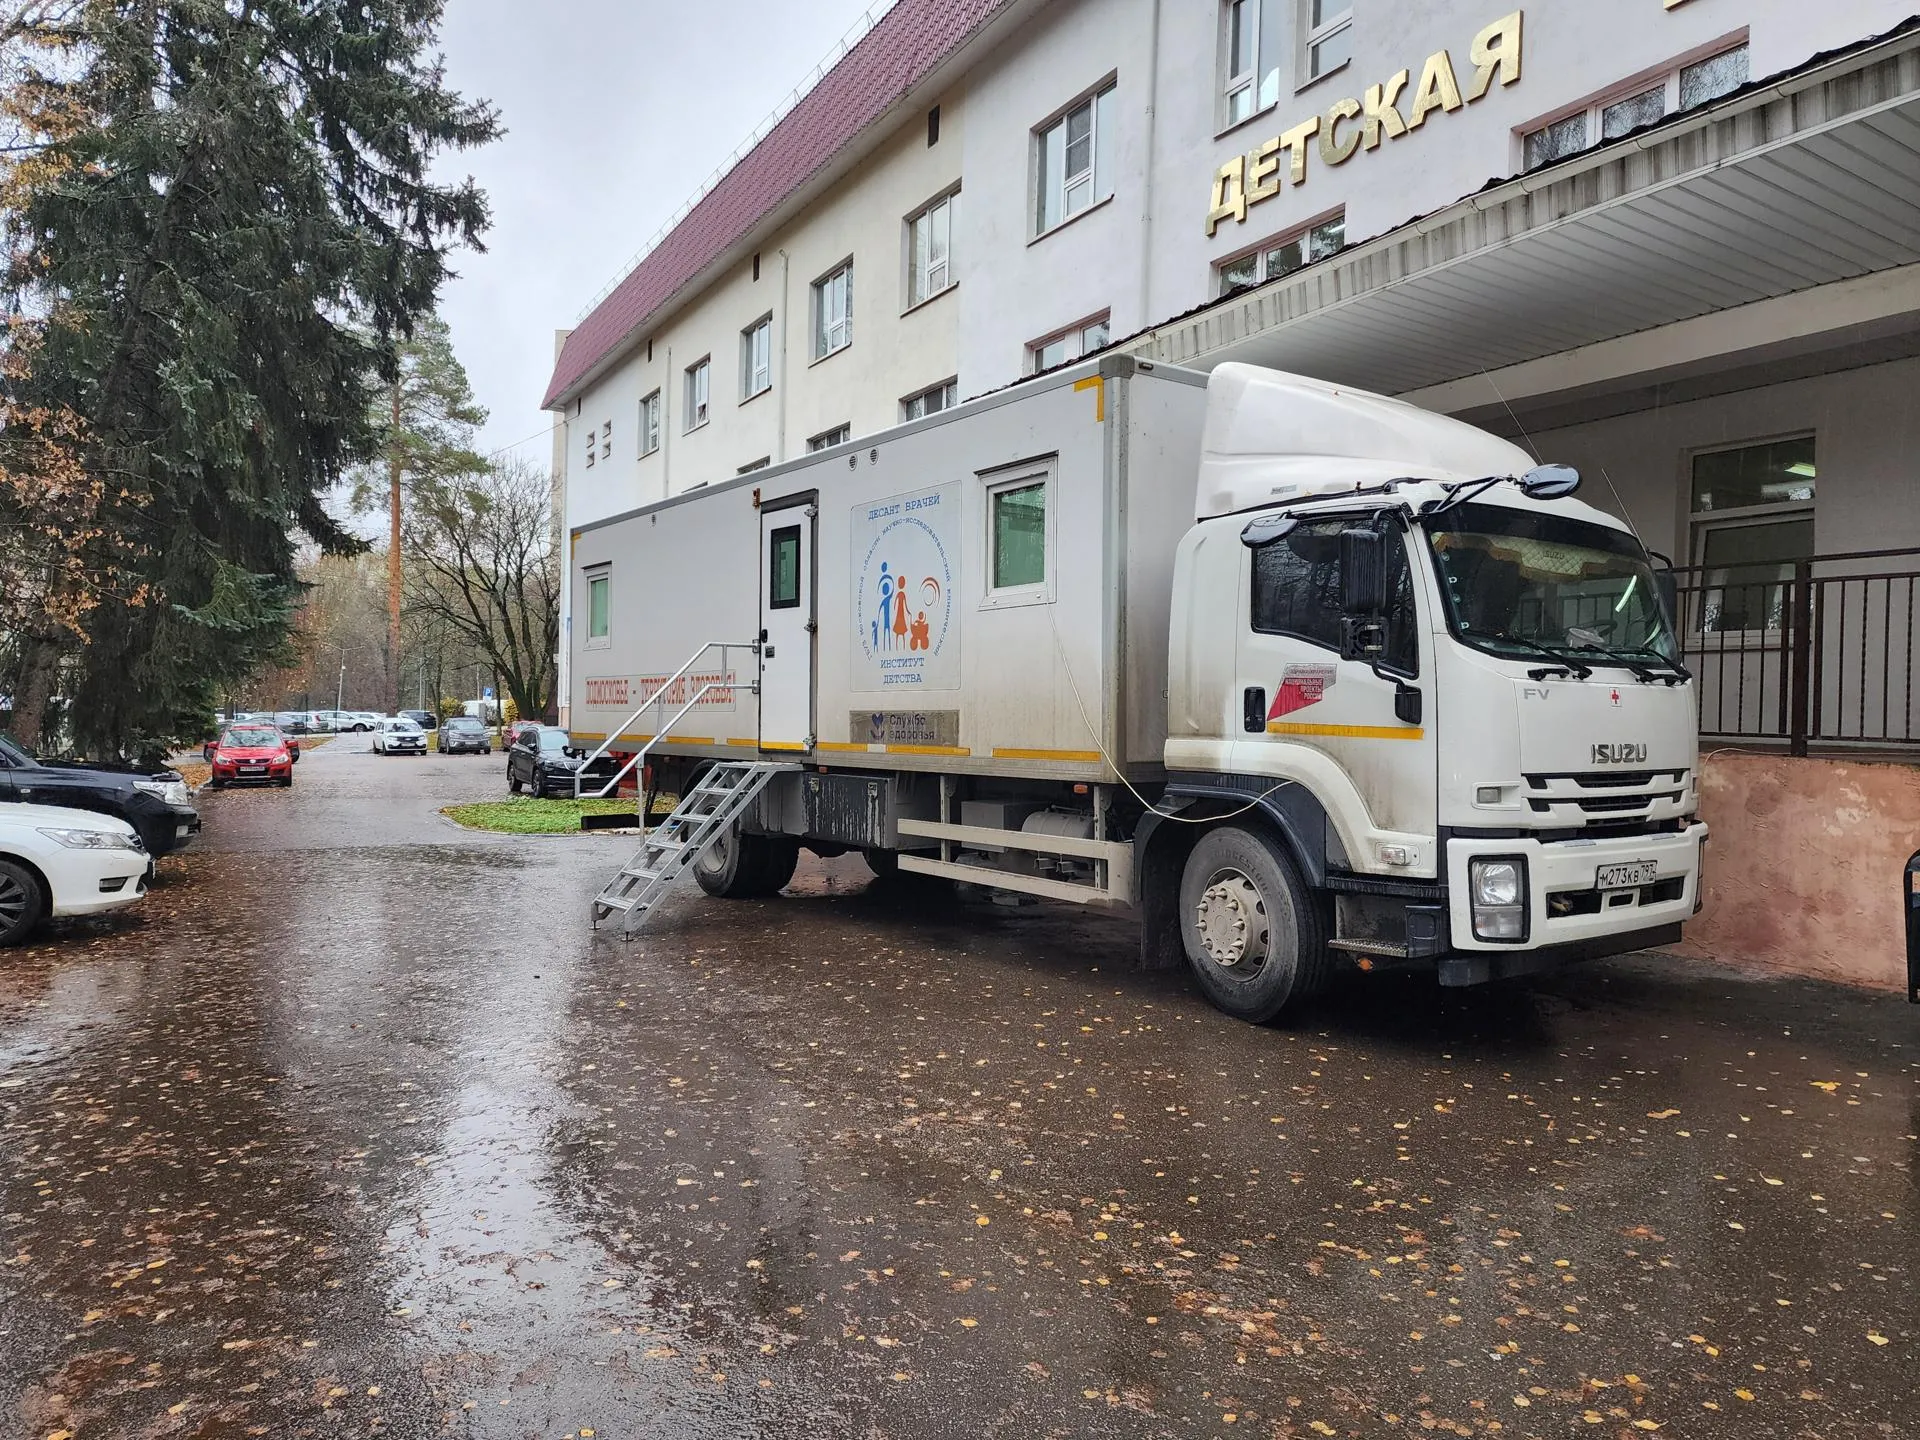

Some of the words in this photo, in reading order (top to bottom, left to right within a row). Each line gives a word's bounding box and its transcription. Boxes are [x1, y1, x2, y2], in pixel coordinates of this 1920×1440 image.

[1205, 9, 1524, 237] ДЕТСКАЯ
[868, 504, 900, 520] ДЕСАНТ
[905, 492, 940, 511] ВРАЧЕЙ
[864, 535, 881, 571] области
[880, 658, 925, 669] ИНСТИТУТ
[883, 673, 923, 685] ДЕТСТВА
[1524, 688, 1549, 700] FV
[1591, 743, 1647, 764] ISUZU
